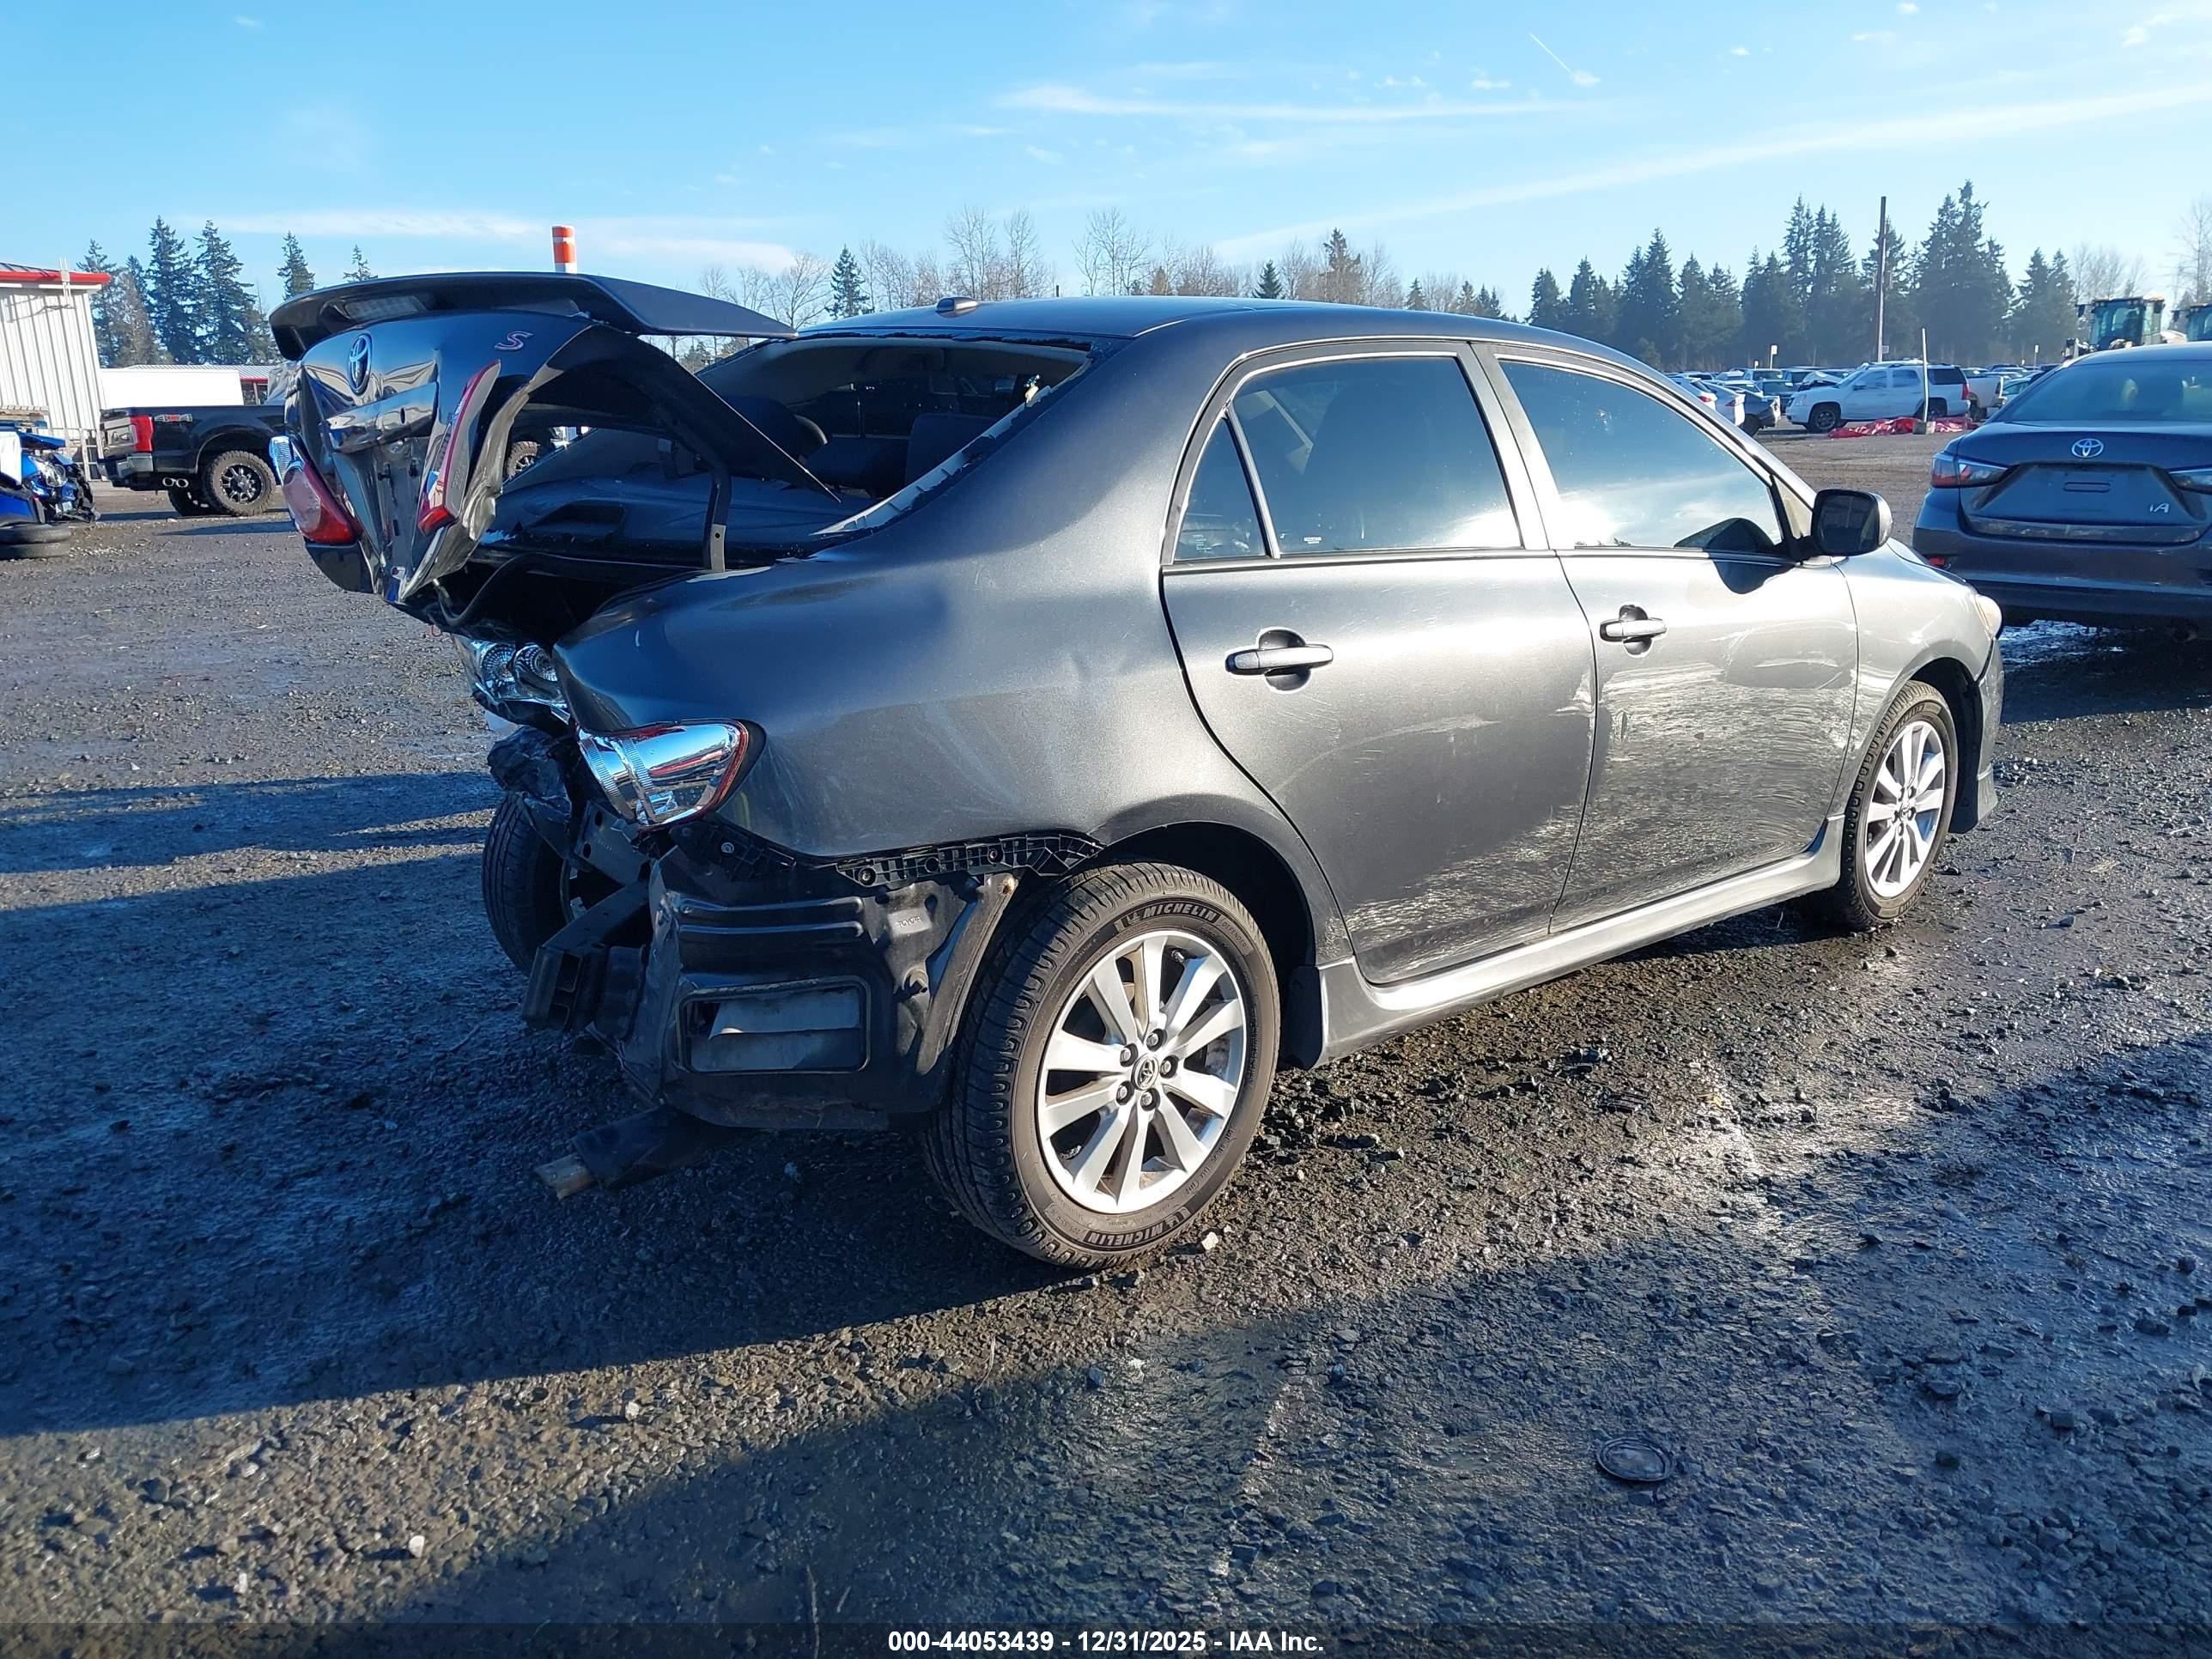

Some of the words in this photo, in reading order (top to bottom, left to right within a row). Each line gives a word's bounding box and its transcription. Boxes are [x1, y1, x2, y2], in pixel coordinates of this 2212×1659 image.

[494, 331, 533, 351] S
[1143, 902, 1218, 923] MICHELIN
[1087, 1222, 1164, 1246] MICHELIN
